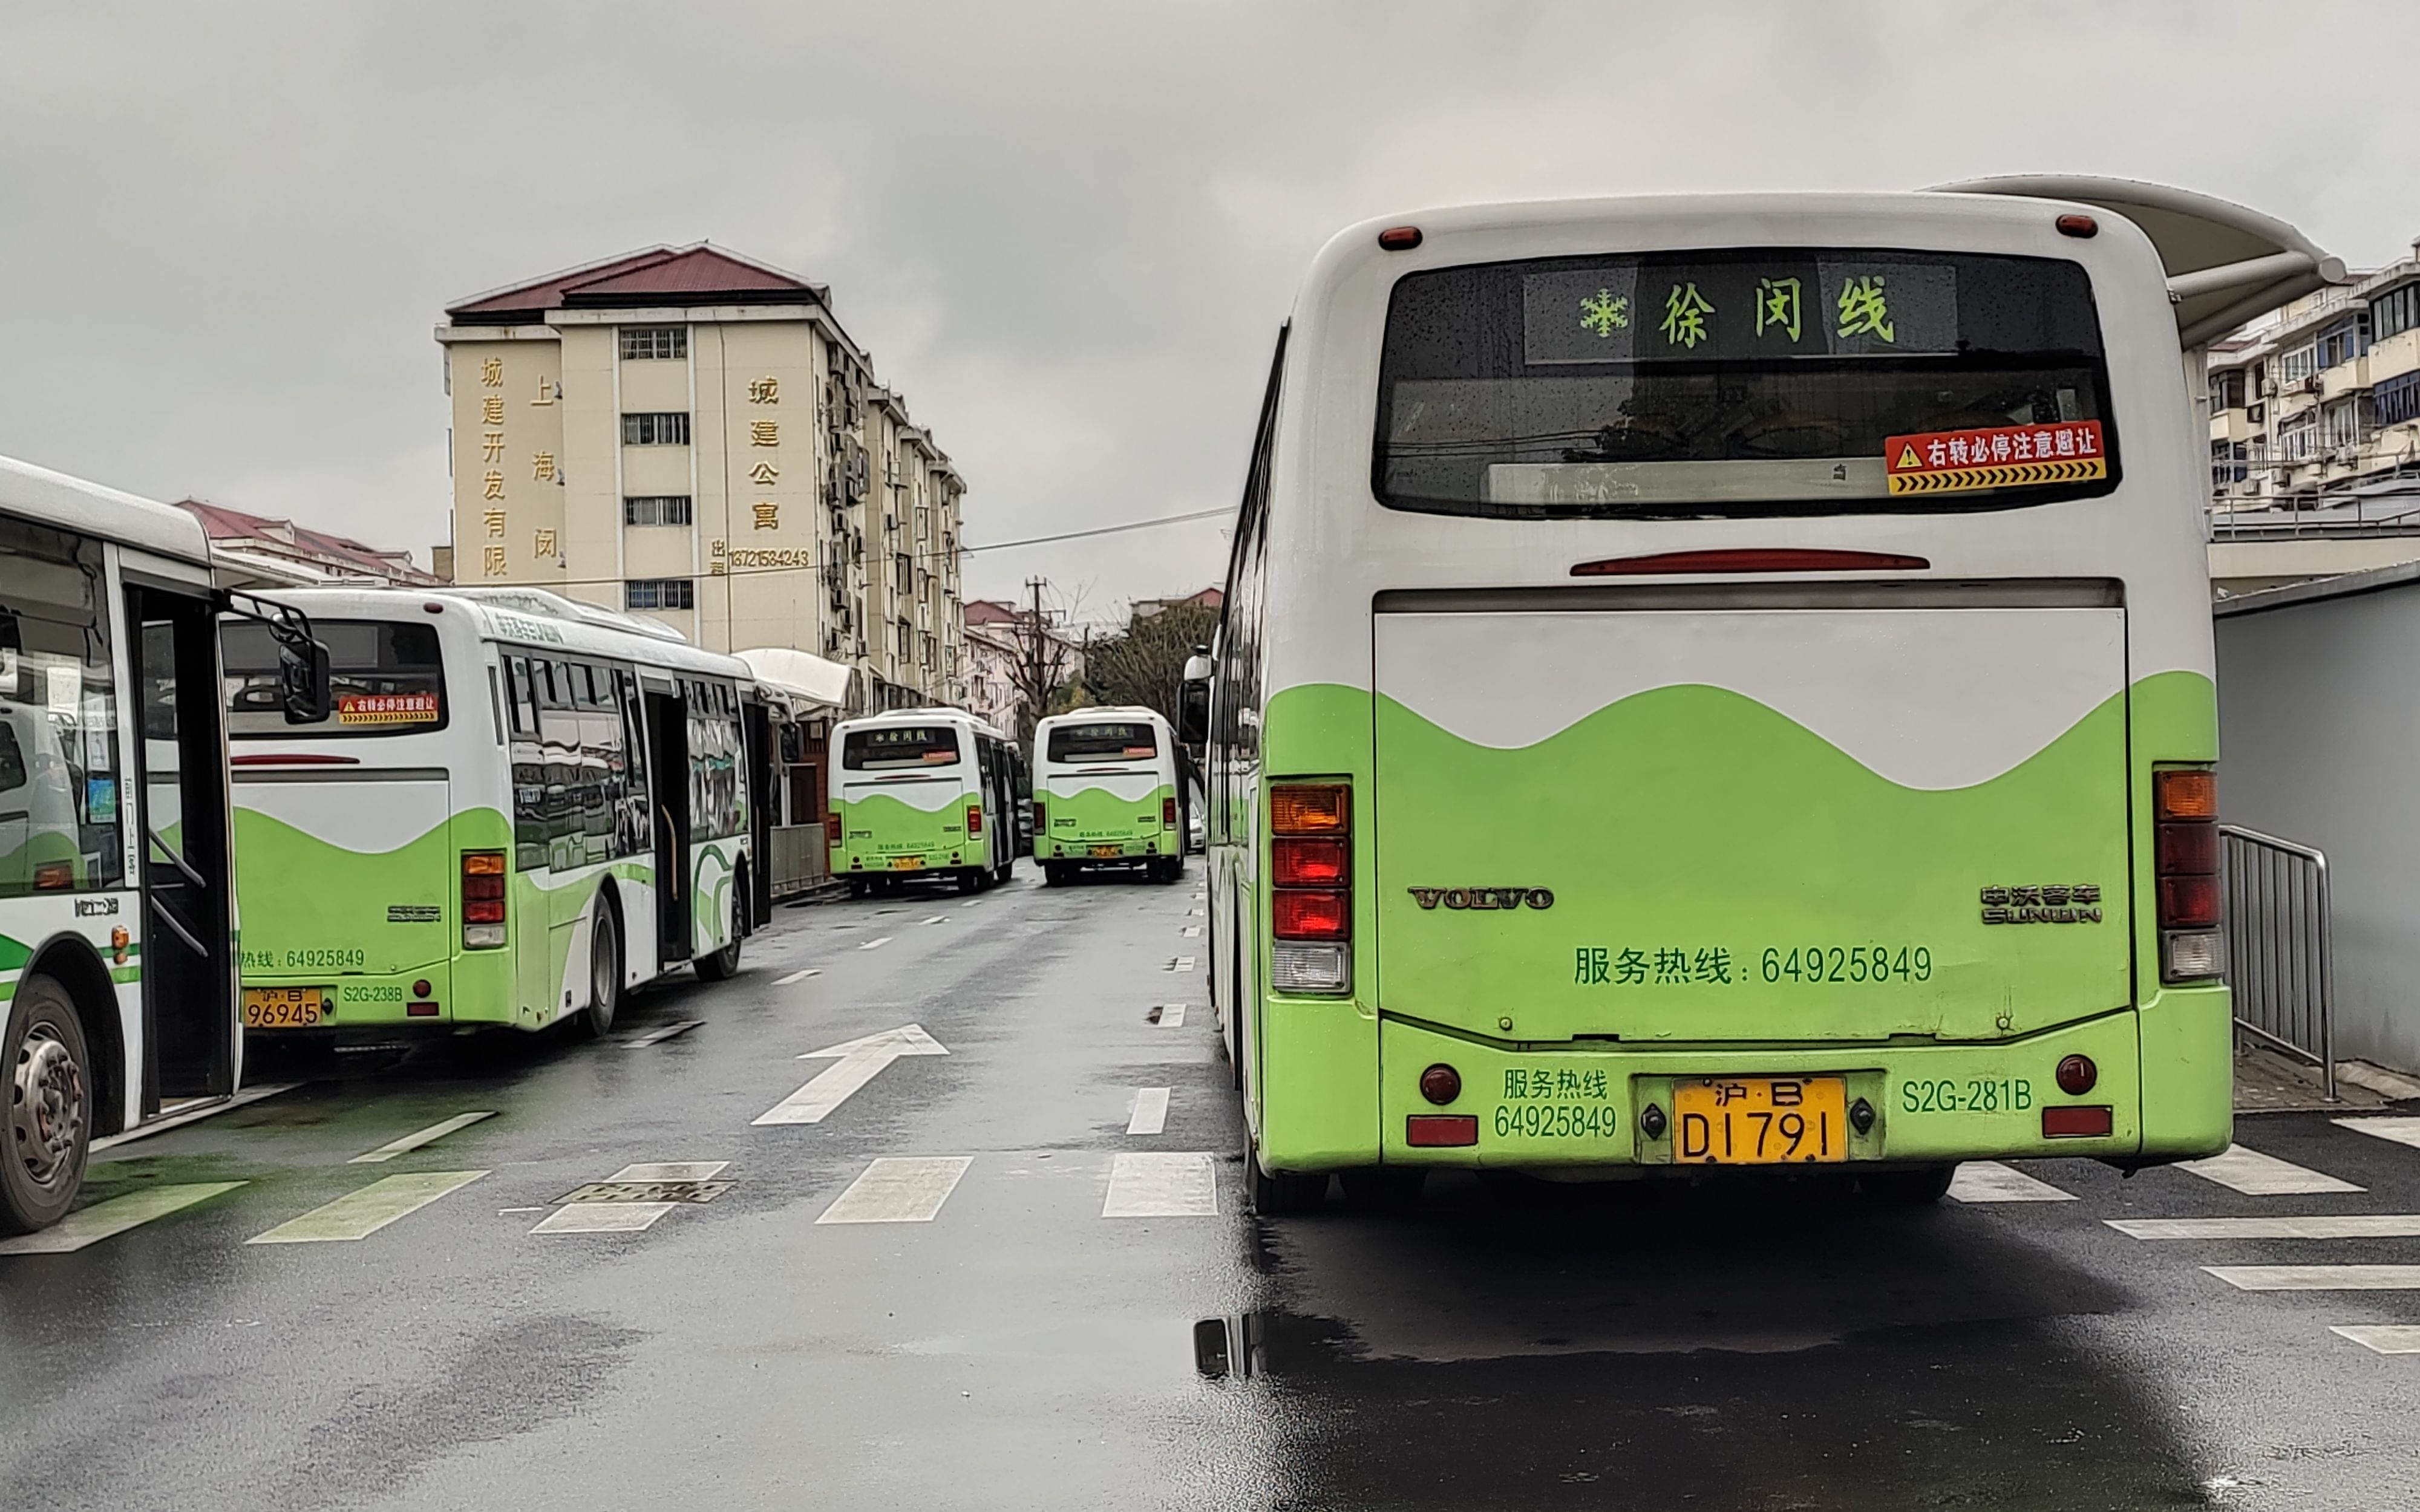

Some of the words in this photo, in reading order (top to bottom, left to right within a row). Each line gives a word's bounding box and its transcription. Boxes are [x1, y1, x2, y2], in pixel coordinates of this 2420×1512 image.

[1659, 276, 1894, 349] 徐闵线
[748, 376, 780, 530] 城建公寓
[1926, 427, 2097, 468] 右转必停注意避让
[482, 357, 507, 576] 城建开发有限
[531, 374, 557, 559] 上海闵
[1408, 887, 1554, 910] VOLVO
[1981, 885, 2101, 907] 申沃客车
[343, 986, 403, 1002] S2G-238B
[248, 1003, 317, 1025] 96945
[1503, 1069, 1607, 1100] 服务热线
[1902, 1079, 2032, 1112] S2G-281B
[1495, 1105, 1616, 1138] 64925849
[1683, 1111, 1828, 1158] D1791
